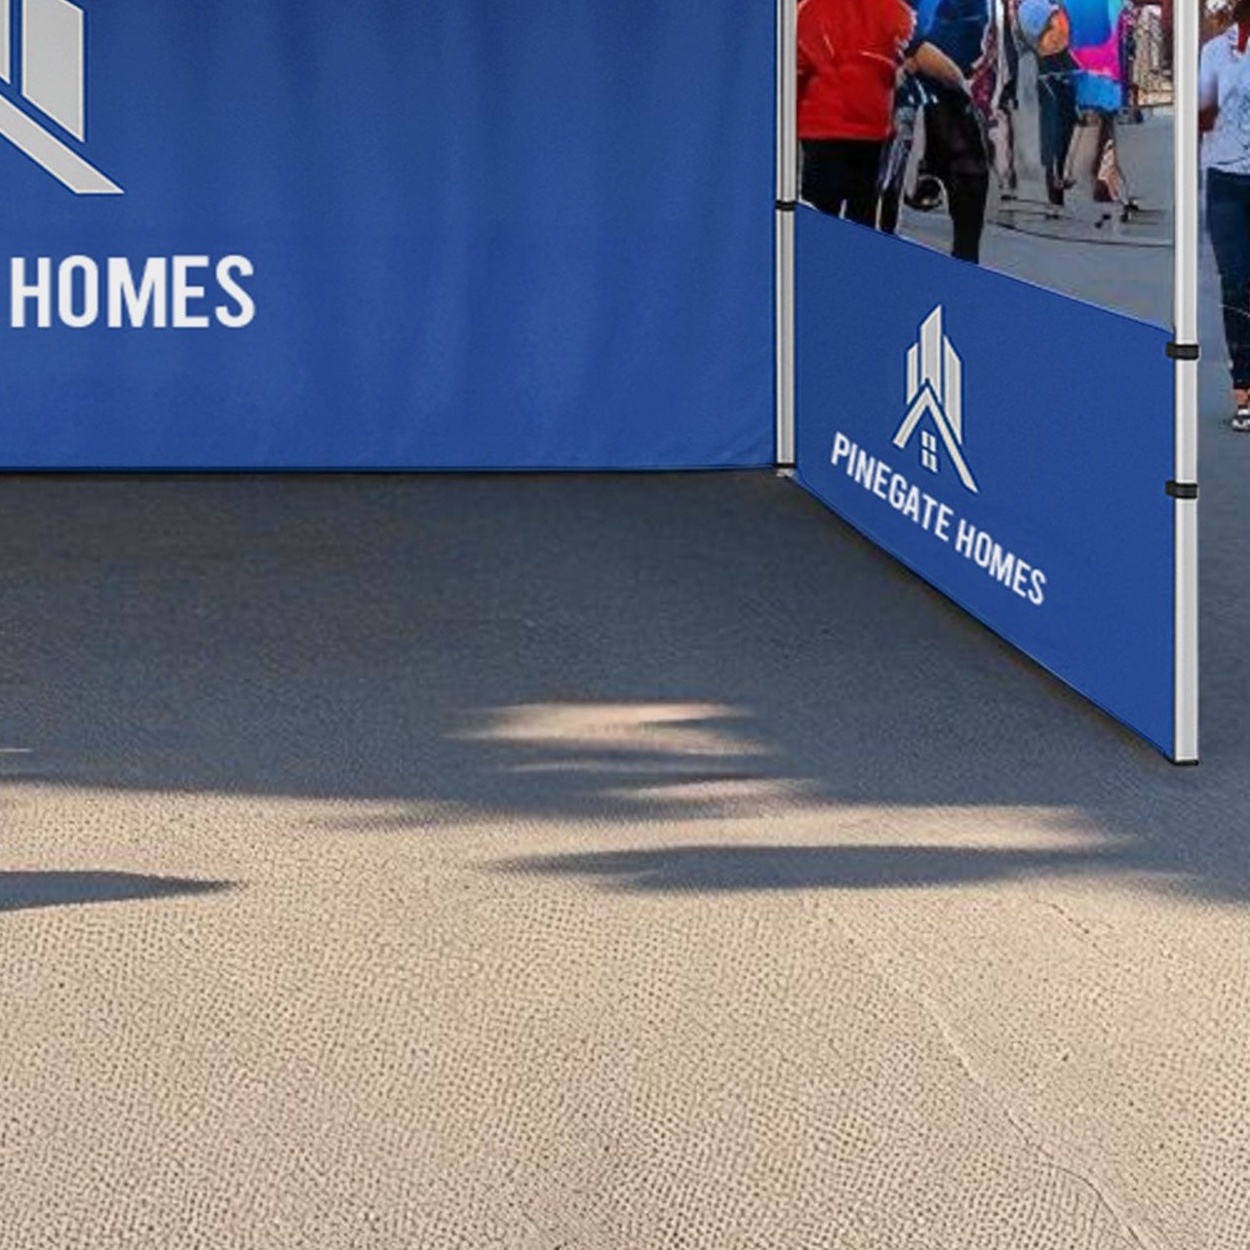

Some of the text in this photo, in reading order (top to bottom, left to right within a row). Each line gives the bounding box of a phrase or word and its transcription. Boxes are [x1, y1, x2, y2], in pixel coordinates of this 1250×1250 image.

[11, 255, 254, 327] HOMES
[832, 433, 1045, 604] PINEGATE HOMES
